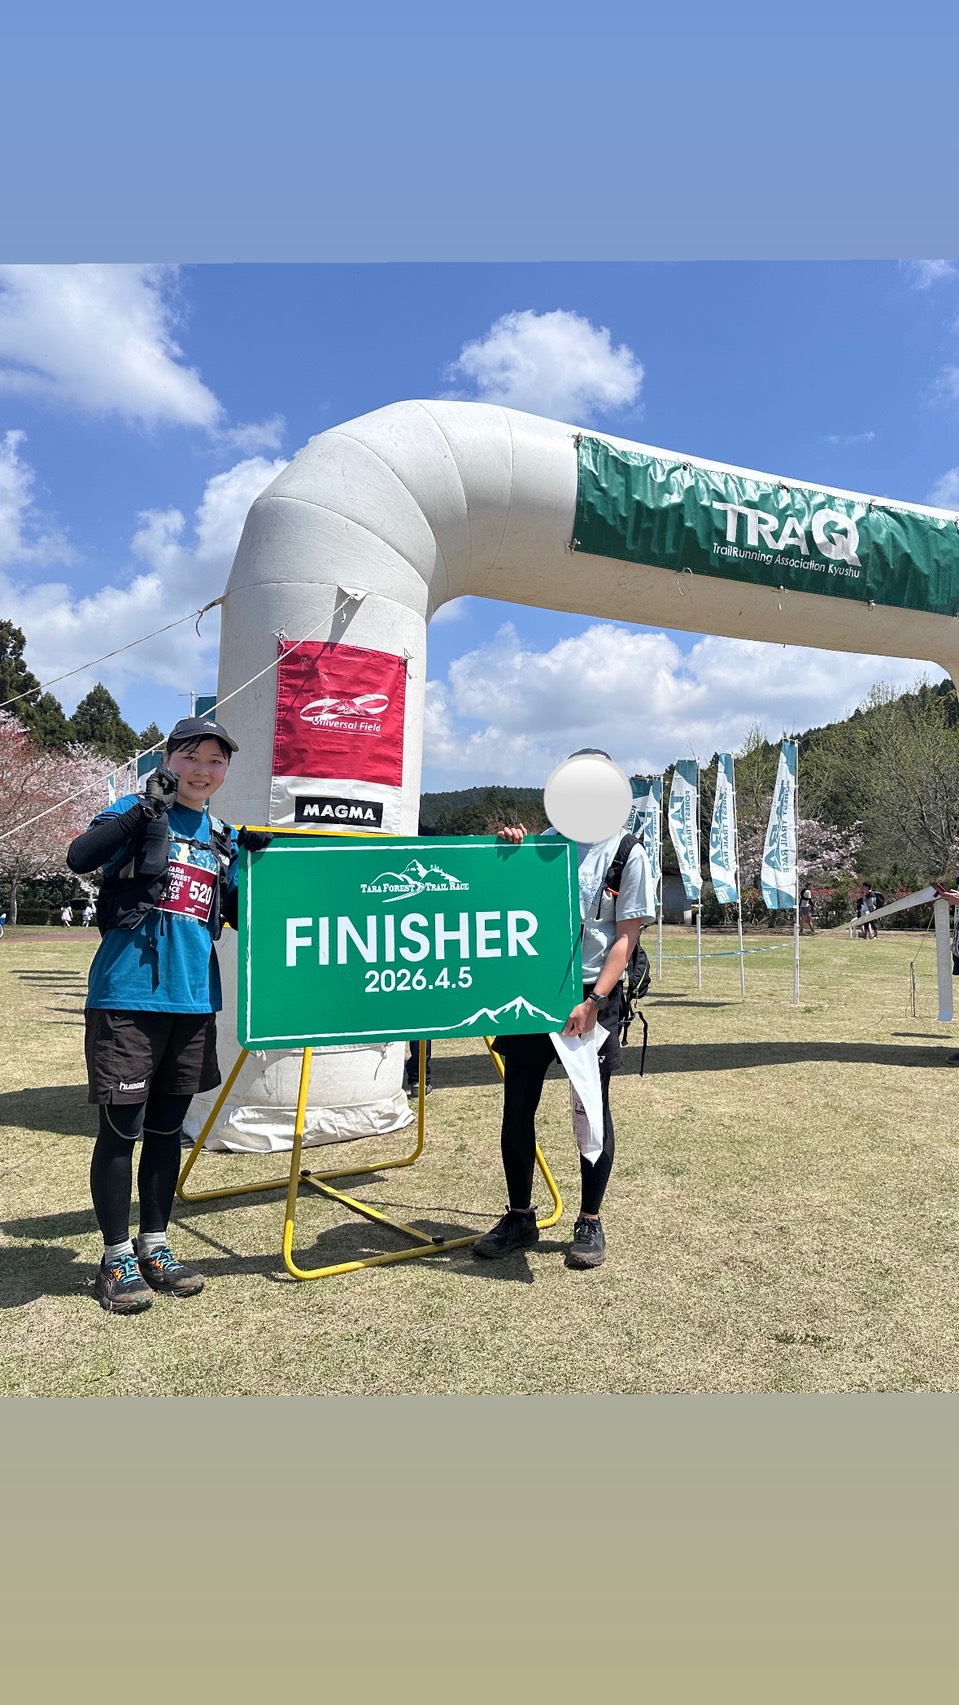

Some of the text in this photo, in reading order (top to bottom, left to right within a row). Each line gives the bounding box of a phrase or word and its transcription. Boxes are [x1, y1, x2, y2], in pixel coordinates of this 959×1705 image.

[712, 501, 862, 567] TRAQ
[712, 543, 860, 578] TrailRunning Association Kyushu
[311, 717, 381, 732] Universal Field
[302, 804, 376, 821] MAGMA
[168, 871, 191, 882] OREST
[360, 881, 469, 893] TARA FOREST TRAIL RACE
[189, 880, 213, 905] 520
[286, 910, 539, 967] FINISHER
[364, 967, 473, 993] 2026.4.5
